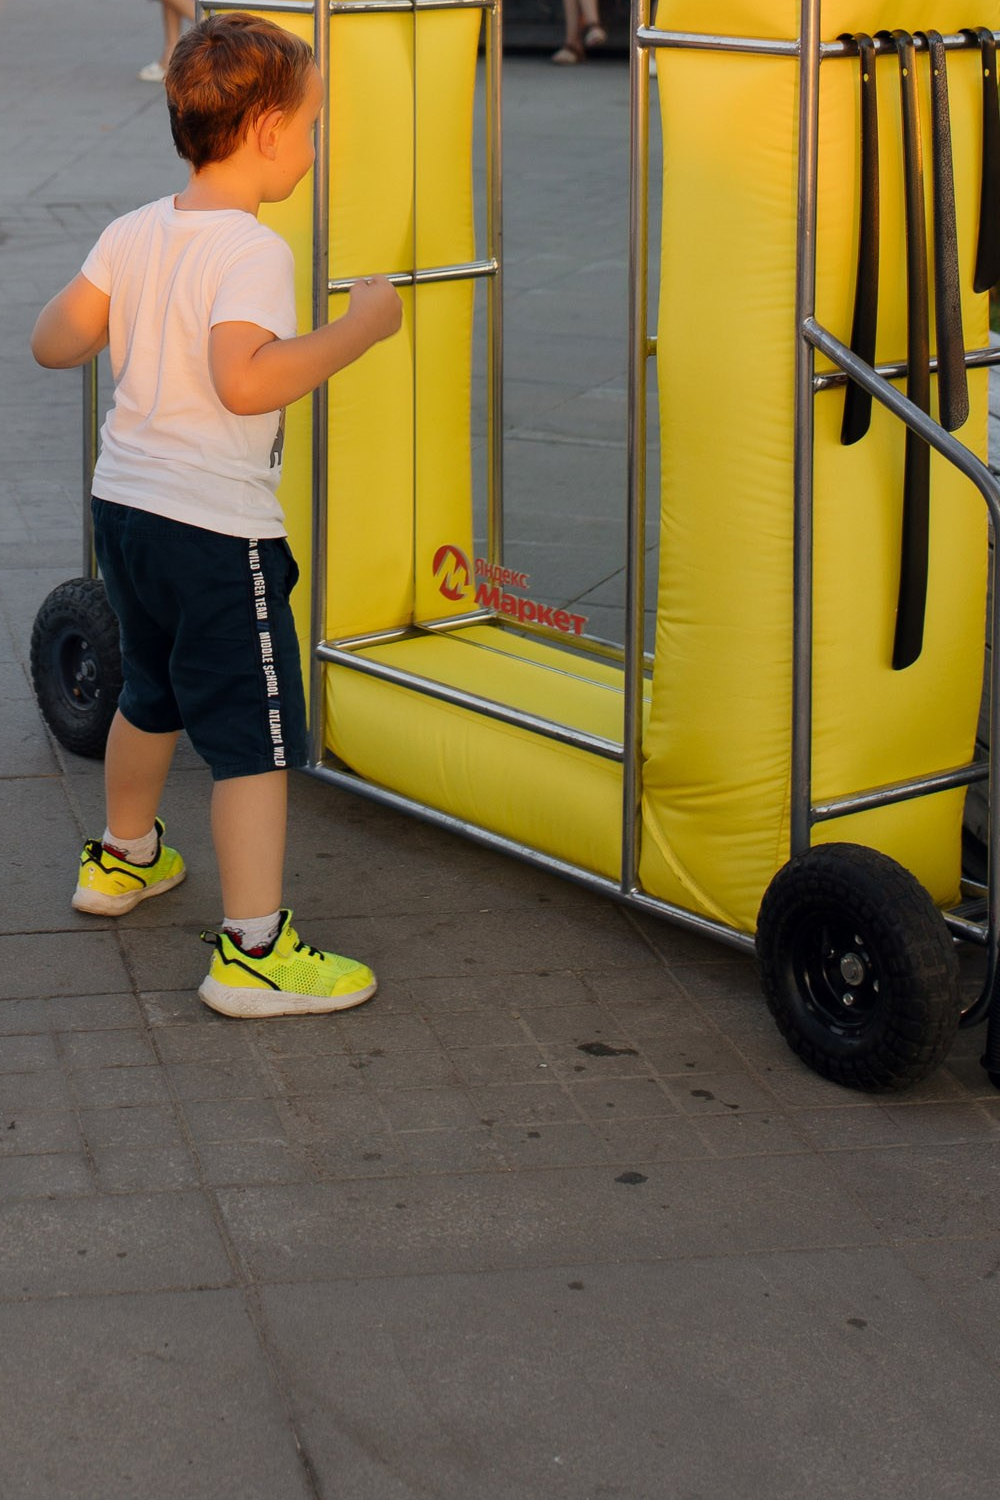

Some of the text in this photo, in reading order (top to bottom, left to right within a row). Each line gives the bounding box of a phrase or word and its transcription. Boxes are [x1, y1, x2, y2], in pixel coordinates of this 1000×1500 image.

[248, 549, 260, 570] WILD
[474, 557, 530, 589] Яндекс
[252, 571, 267, 597] TIGER
[254, 597, 268, 620] TEAM
[474, 583, 588, 636] Маркет
[259, 631, 274, 663] MIDDLE
[262, 664, 279, 697] SCHOOL
[269, 709, 283, 744] ATLANTA
[274, 746, 287, 767] WILD
